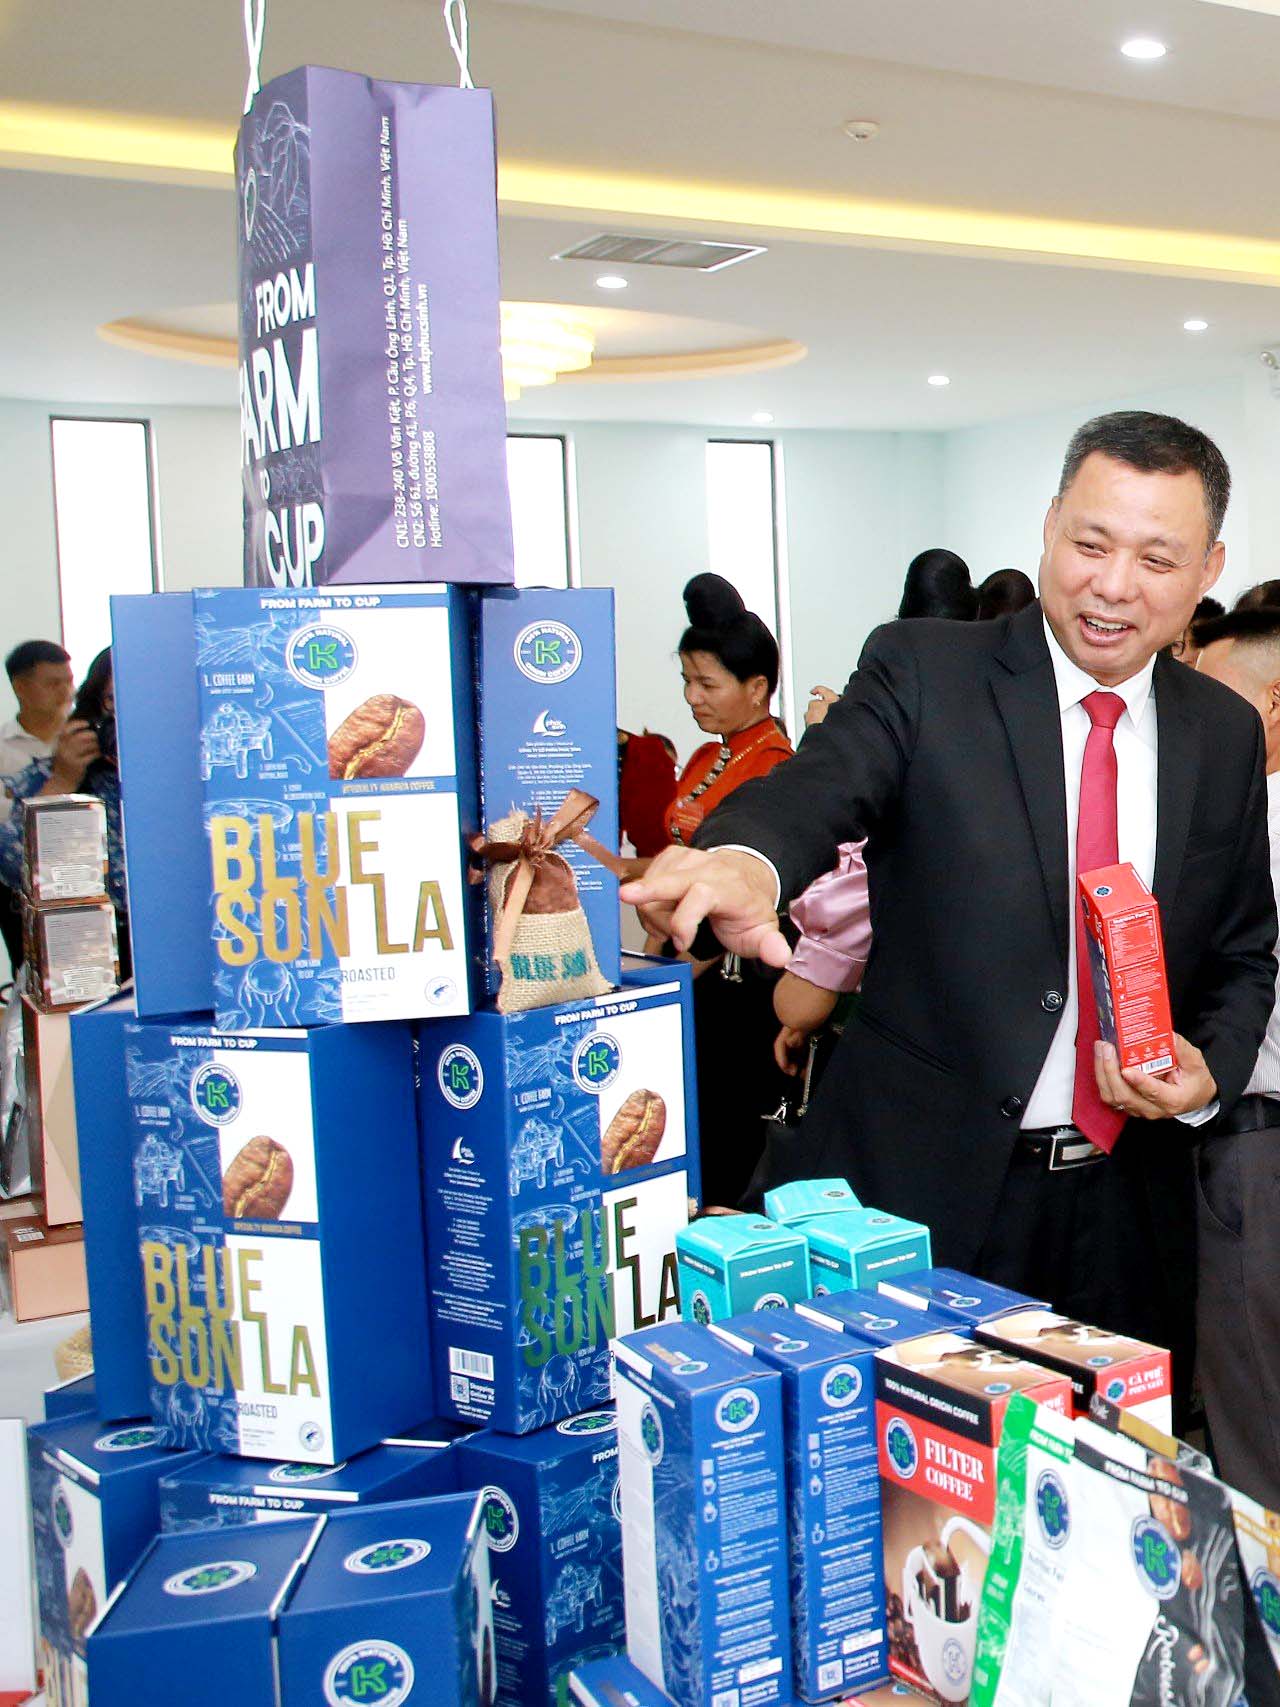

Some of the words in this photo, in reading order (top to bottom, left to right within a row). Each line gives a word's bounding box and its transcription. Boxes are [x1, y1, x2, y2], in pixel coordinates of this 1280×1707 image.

[380, 116, 389, 145] Nam
[398, 219, 408, 243] Nam
[256, 263, 316, 338] FROM
[423, 430, 438, 500] 1900558808
[393, 470, 407, 517] 238-240
[265, 503, 324, 587] CUP
[397, 520, 410, 548] CN1:
[413, 522, 427, 548] CN2:
[428, 503, 442, 548] Hotline:
[260, 598, 297, 609] FROM
[298, 598, 332, 608] FARM
[335, 598, 352, 608] TO
[354, 597, 381, 607] CUP
[210, 810, 381, 893] BLUE
[216, 884, 351, 967] SON
[374, 873, 454, 955] LA
[340, 967, 395, 982] ROASTED
[555, 1012, 580, 1025] FROM
[581, 1008, 605, 1021] FARM
[606, 1005, 620, 1016] TO
[621, 1002, 638, 1013] CUP
[171, 1036, 196, 1046] FROM
[198, 1037, 222, 1048] FARM
[223, 1038, 236, 1048] TO
[238, 1039, 258, 1049] CUP
[520, 1197, 638, 1292] BLUE
[141, 1241, 267, 1321] BLUE
[524, 1272, 616, 1367] SON
[632, 1252, 682, 1331] LA
[148, 1312, 245, 1391] SON
[259, 1313, 321, 1397] LA
[238, 1403, 277, 1419] ROASTED
[953, 1403, 979, 1426] COFFEE
[924, 1437, 984, 1483] FILTER
[209, 1493, 238, 1505] FROM
[239, 1496, 265, 1508] FARM
[267, 1498, 282, 1509] TO
[283, 1499, 304, 1510] CUP
[926, 1466, 974, 1501] COFFEE
